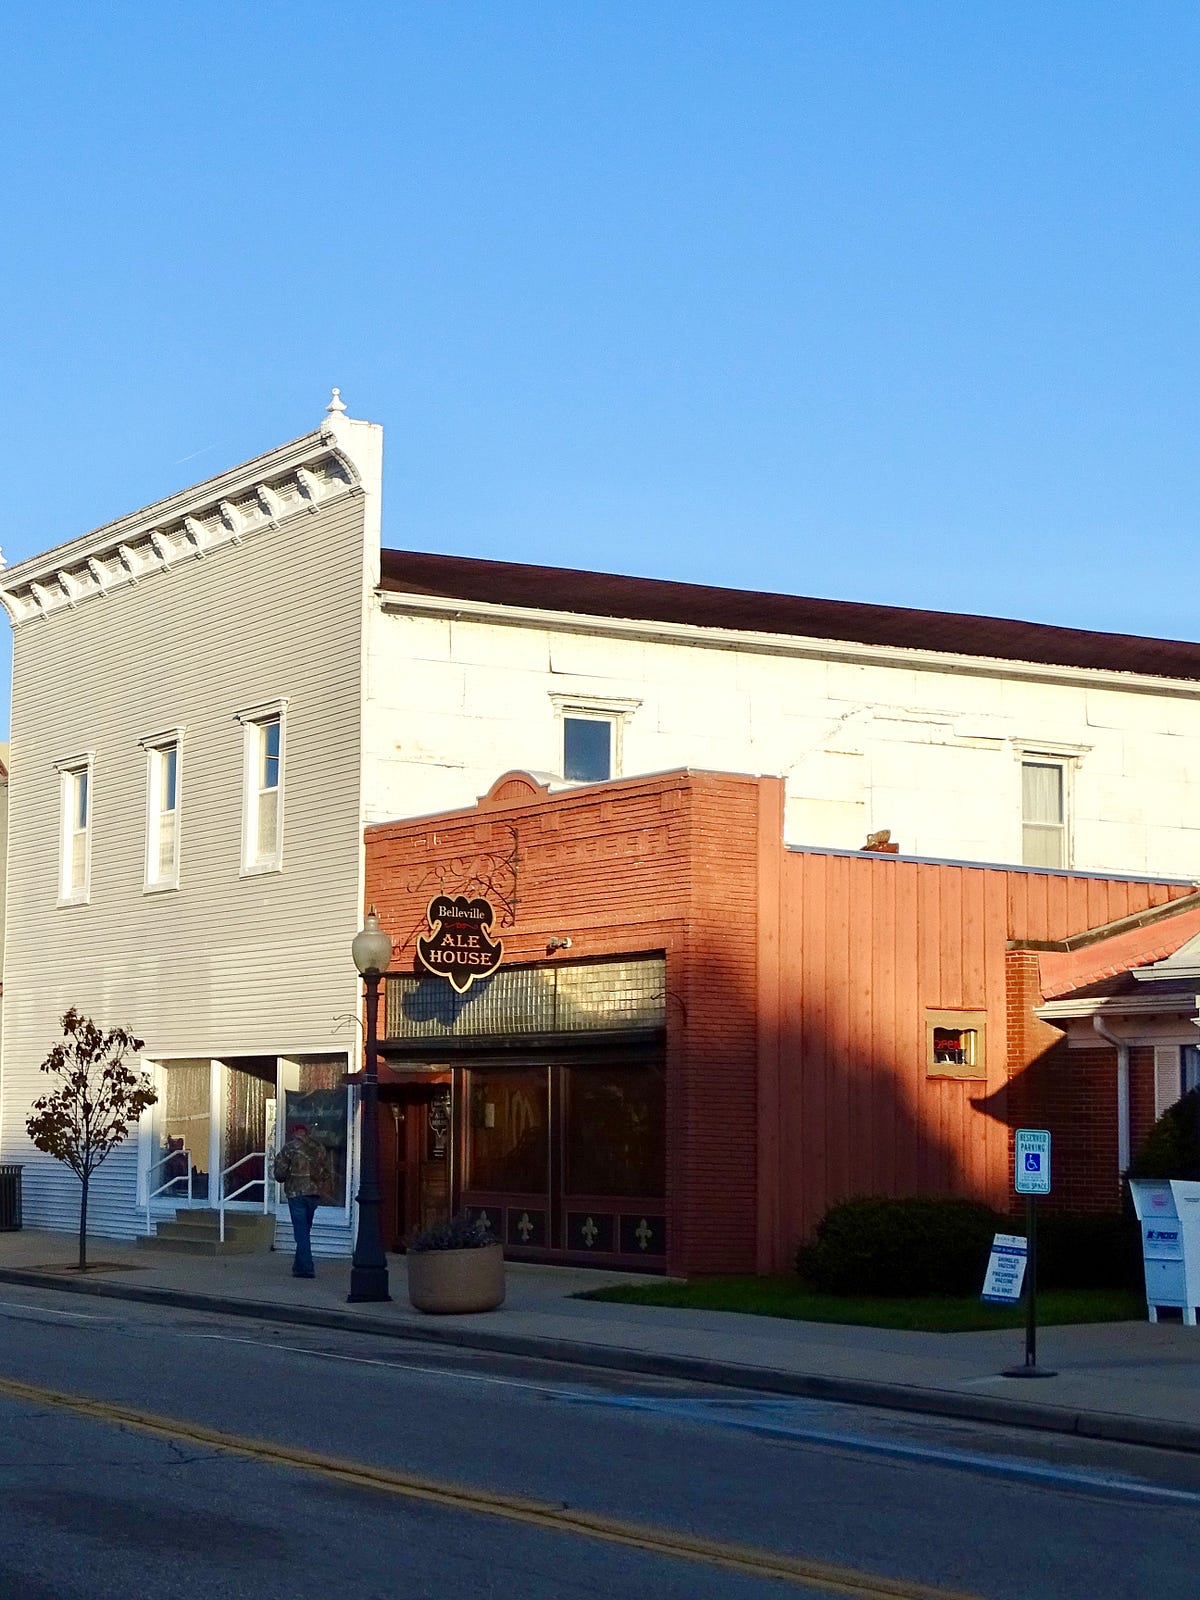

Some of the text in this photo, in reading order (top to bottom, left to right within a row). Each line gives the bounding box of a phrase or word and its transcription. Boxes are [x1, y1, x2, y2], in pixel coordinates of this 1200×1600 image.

[438, 905, 485, 919] Belleville
[440, 933, 480, 948] ALE
[429, 949, 493, 966] HOUSE
[1020, 1133, 1047, 1143] RESERVED
[1020, 1142, 1046, 1153] PARKING
